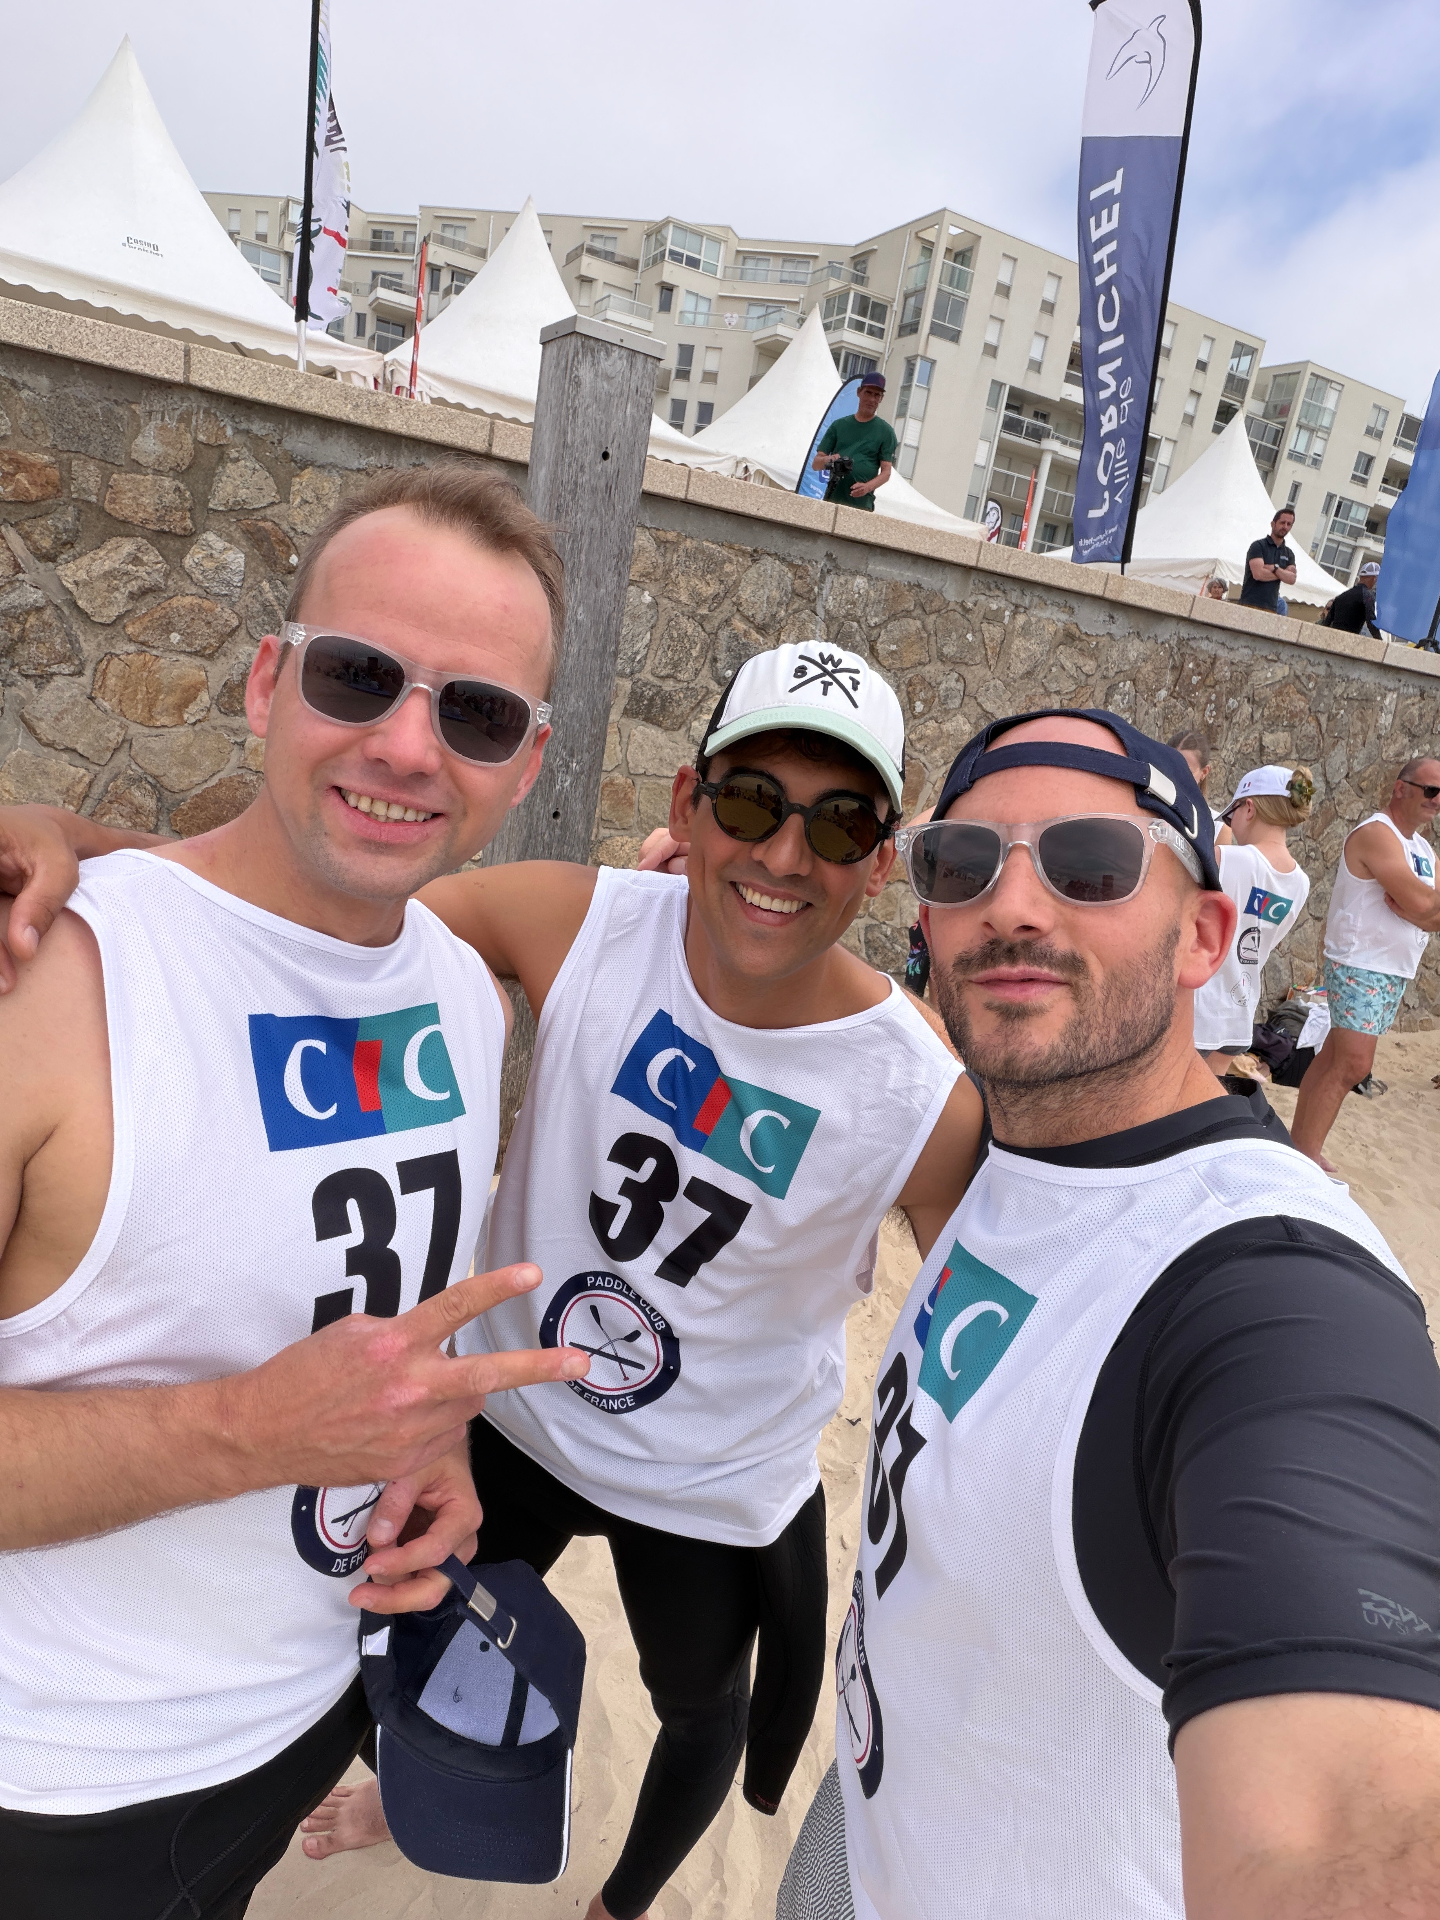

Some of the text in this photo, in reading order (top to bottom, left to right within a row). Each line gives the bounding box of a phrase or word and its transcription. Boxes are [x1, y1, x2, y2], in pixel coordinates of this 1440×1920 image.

[283, 1023, 451, 1120] CIC
[645, 1047, 792, 1174] CIC
[311, 1148, 462, 1336] 37
[588, 1131, 753, 1289] 37
[586, 1276, 666, 1332] PADDLE CLUB
[583, 1394, 636, 1411] FRANCE
[330, 1544, 369, 1573] DE FRA
